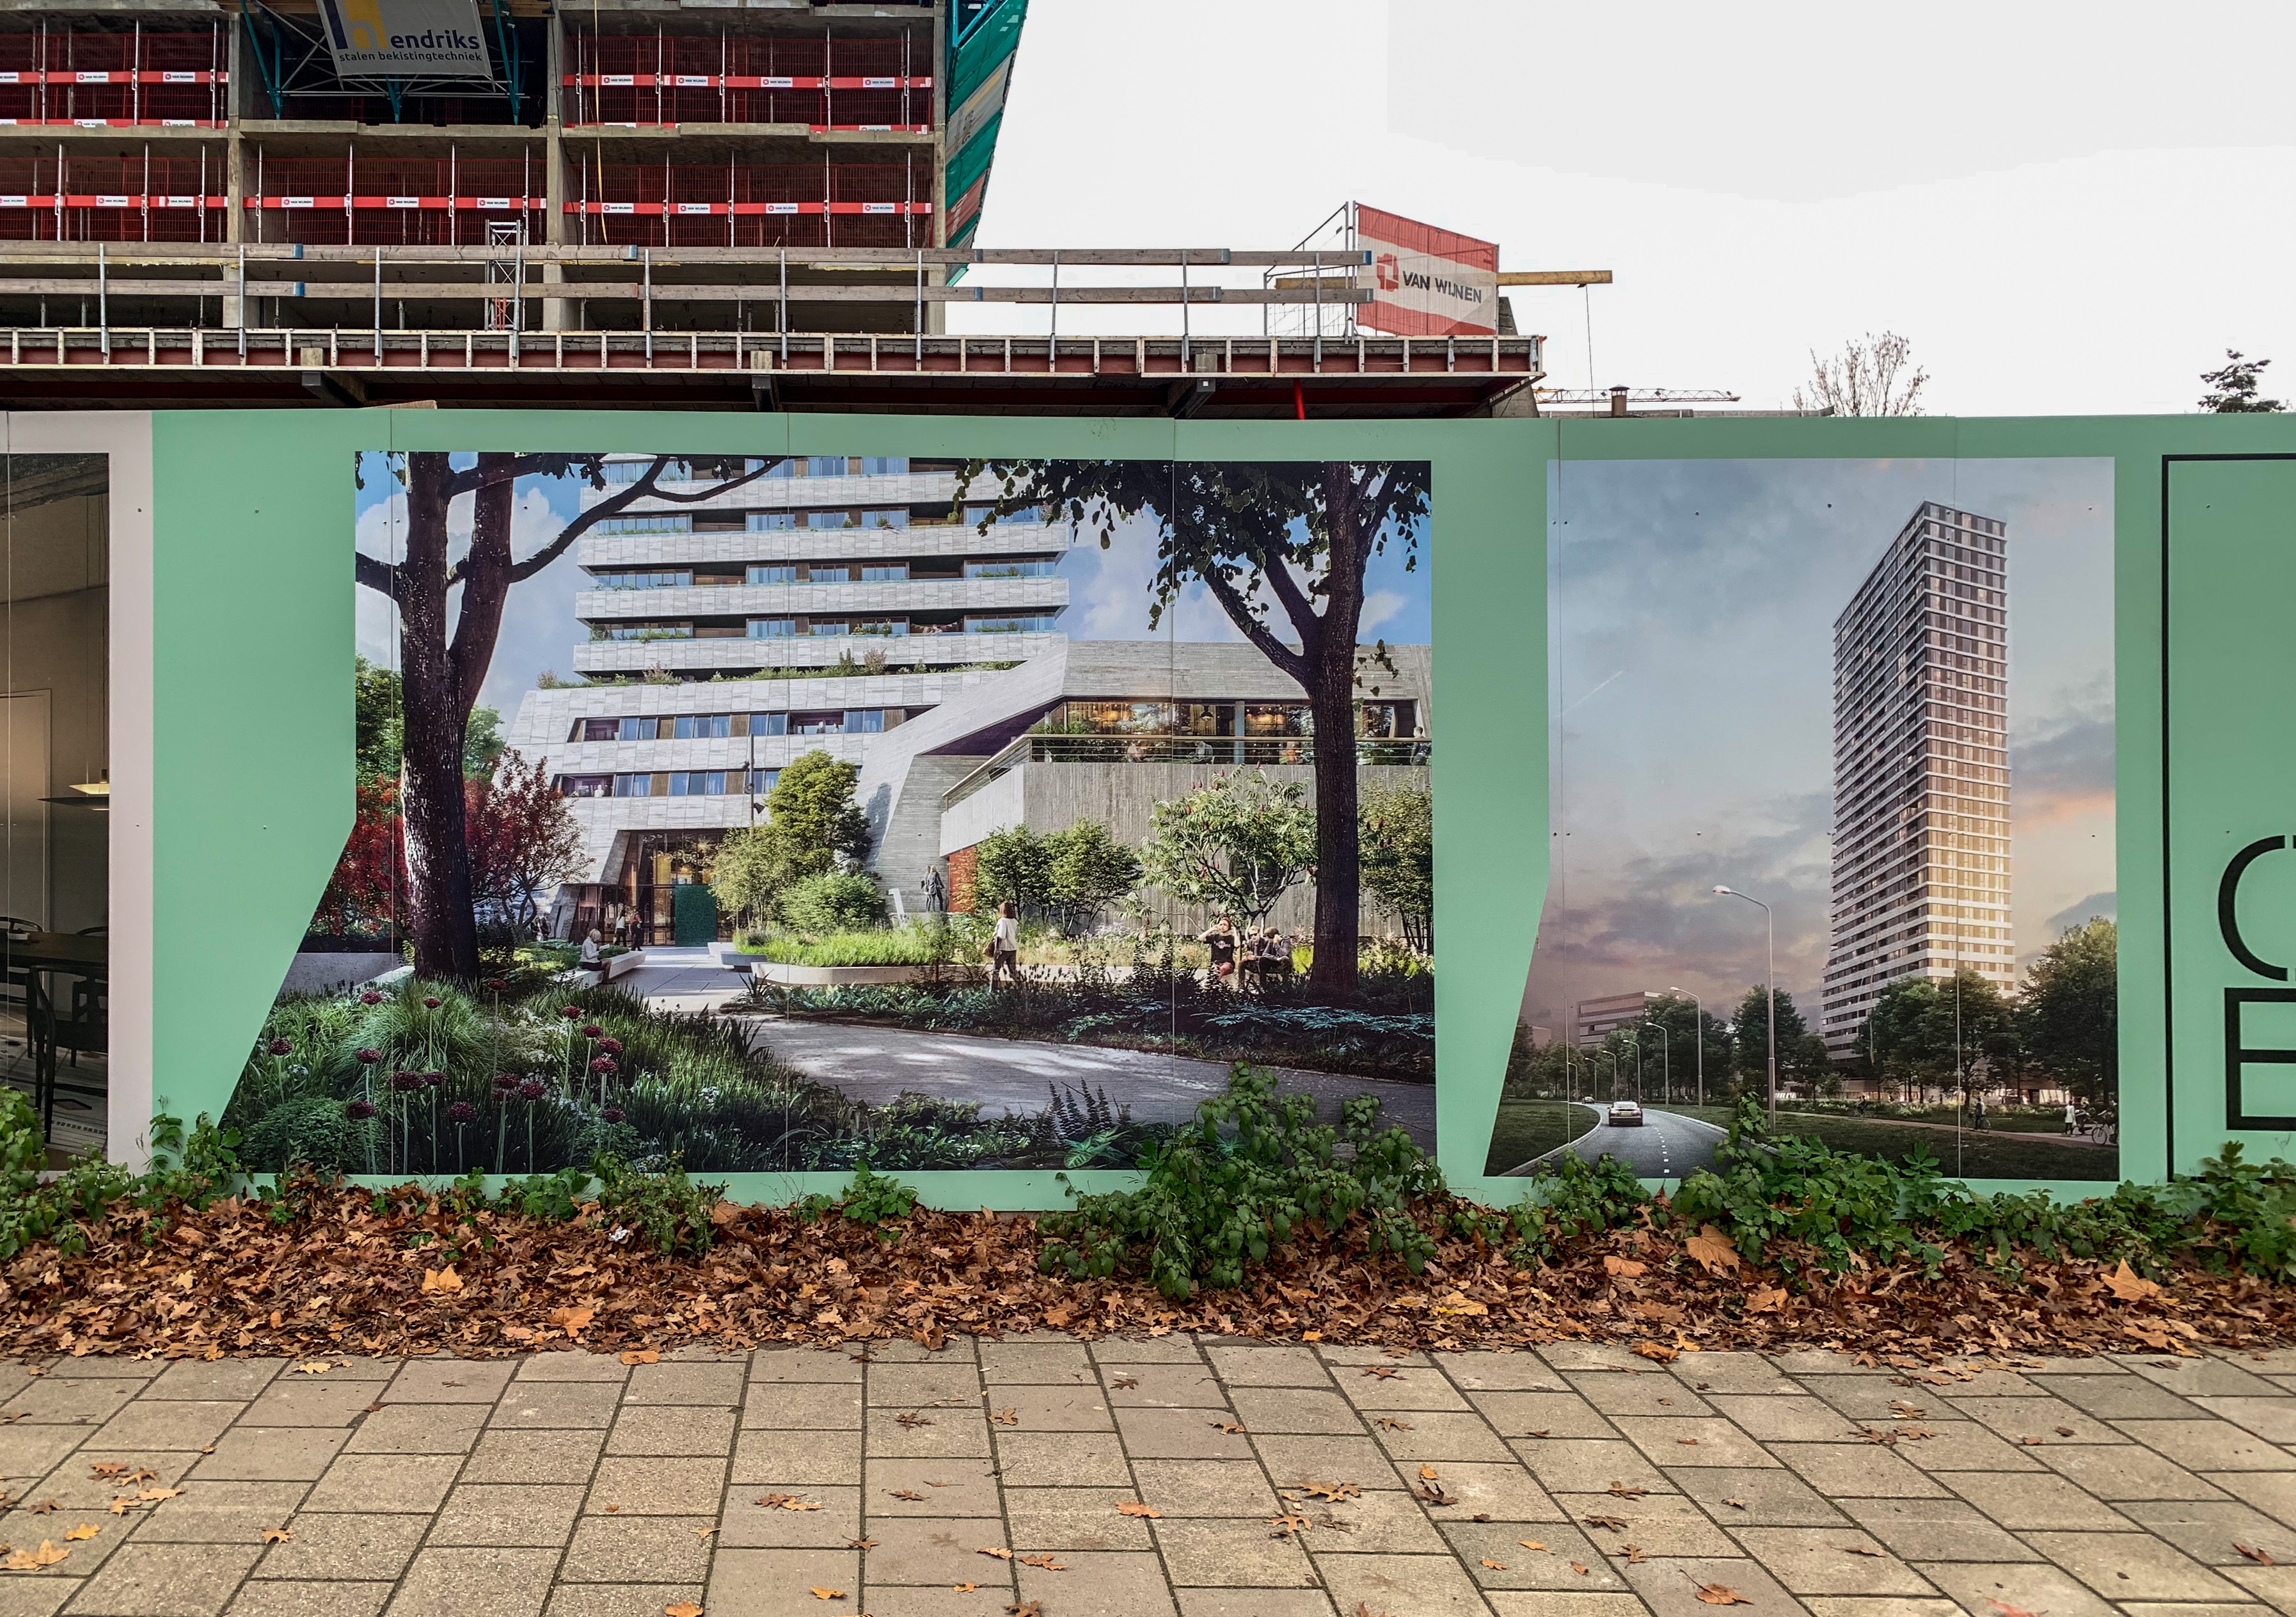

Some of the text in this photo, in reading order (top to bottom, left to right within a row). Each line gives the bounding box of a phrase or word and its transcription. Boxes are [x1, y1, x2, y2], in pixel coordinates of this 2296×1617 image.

[339, 51, 482, 62] stalen bekistingtechniek
[1402, 270, 1482, 304] VAN WIJNEN
